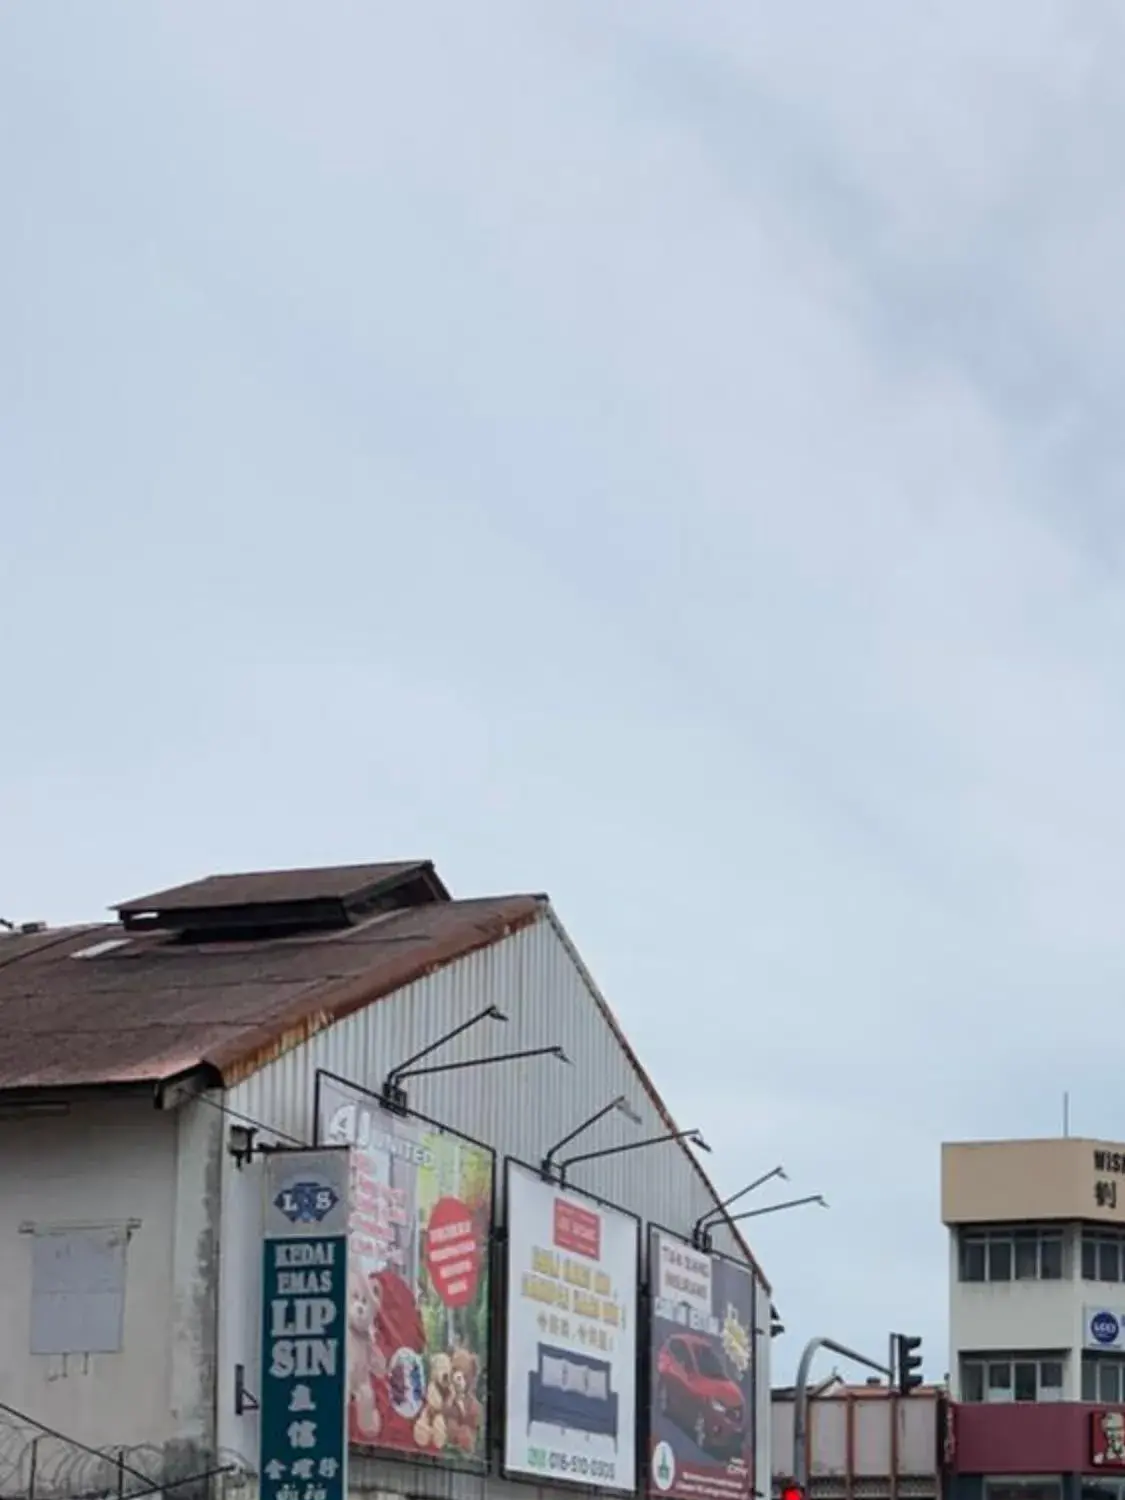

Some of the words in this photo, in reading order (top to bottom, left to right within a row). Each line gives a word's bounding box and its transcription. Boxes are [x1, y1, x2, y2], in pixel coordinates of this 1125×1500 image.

[274, 1243, 336, 1267] KEDAI
[277, 1270, 332, 1294] EMAS
[271, 1299, 337, 1336] LIP
[269, 1340, 337, 1378] SIN
